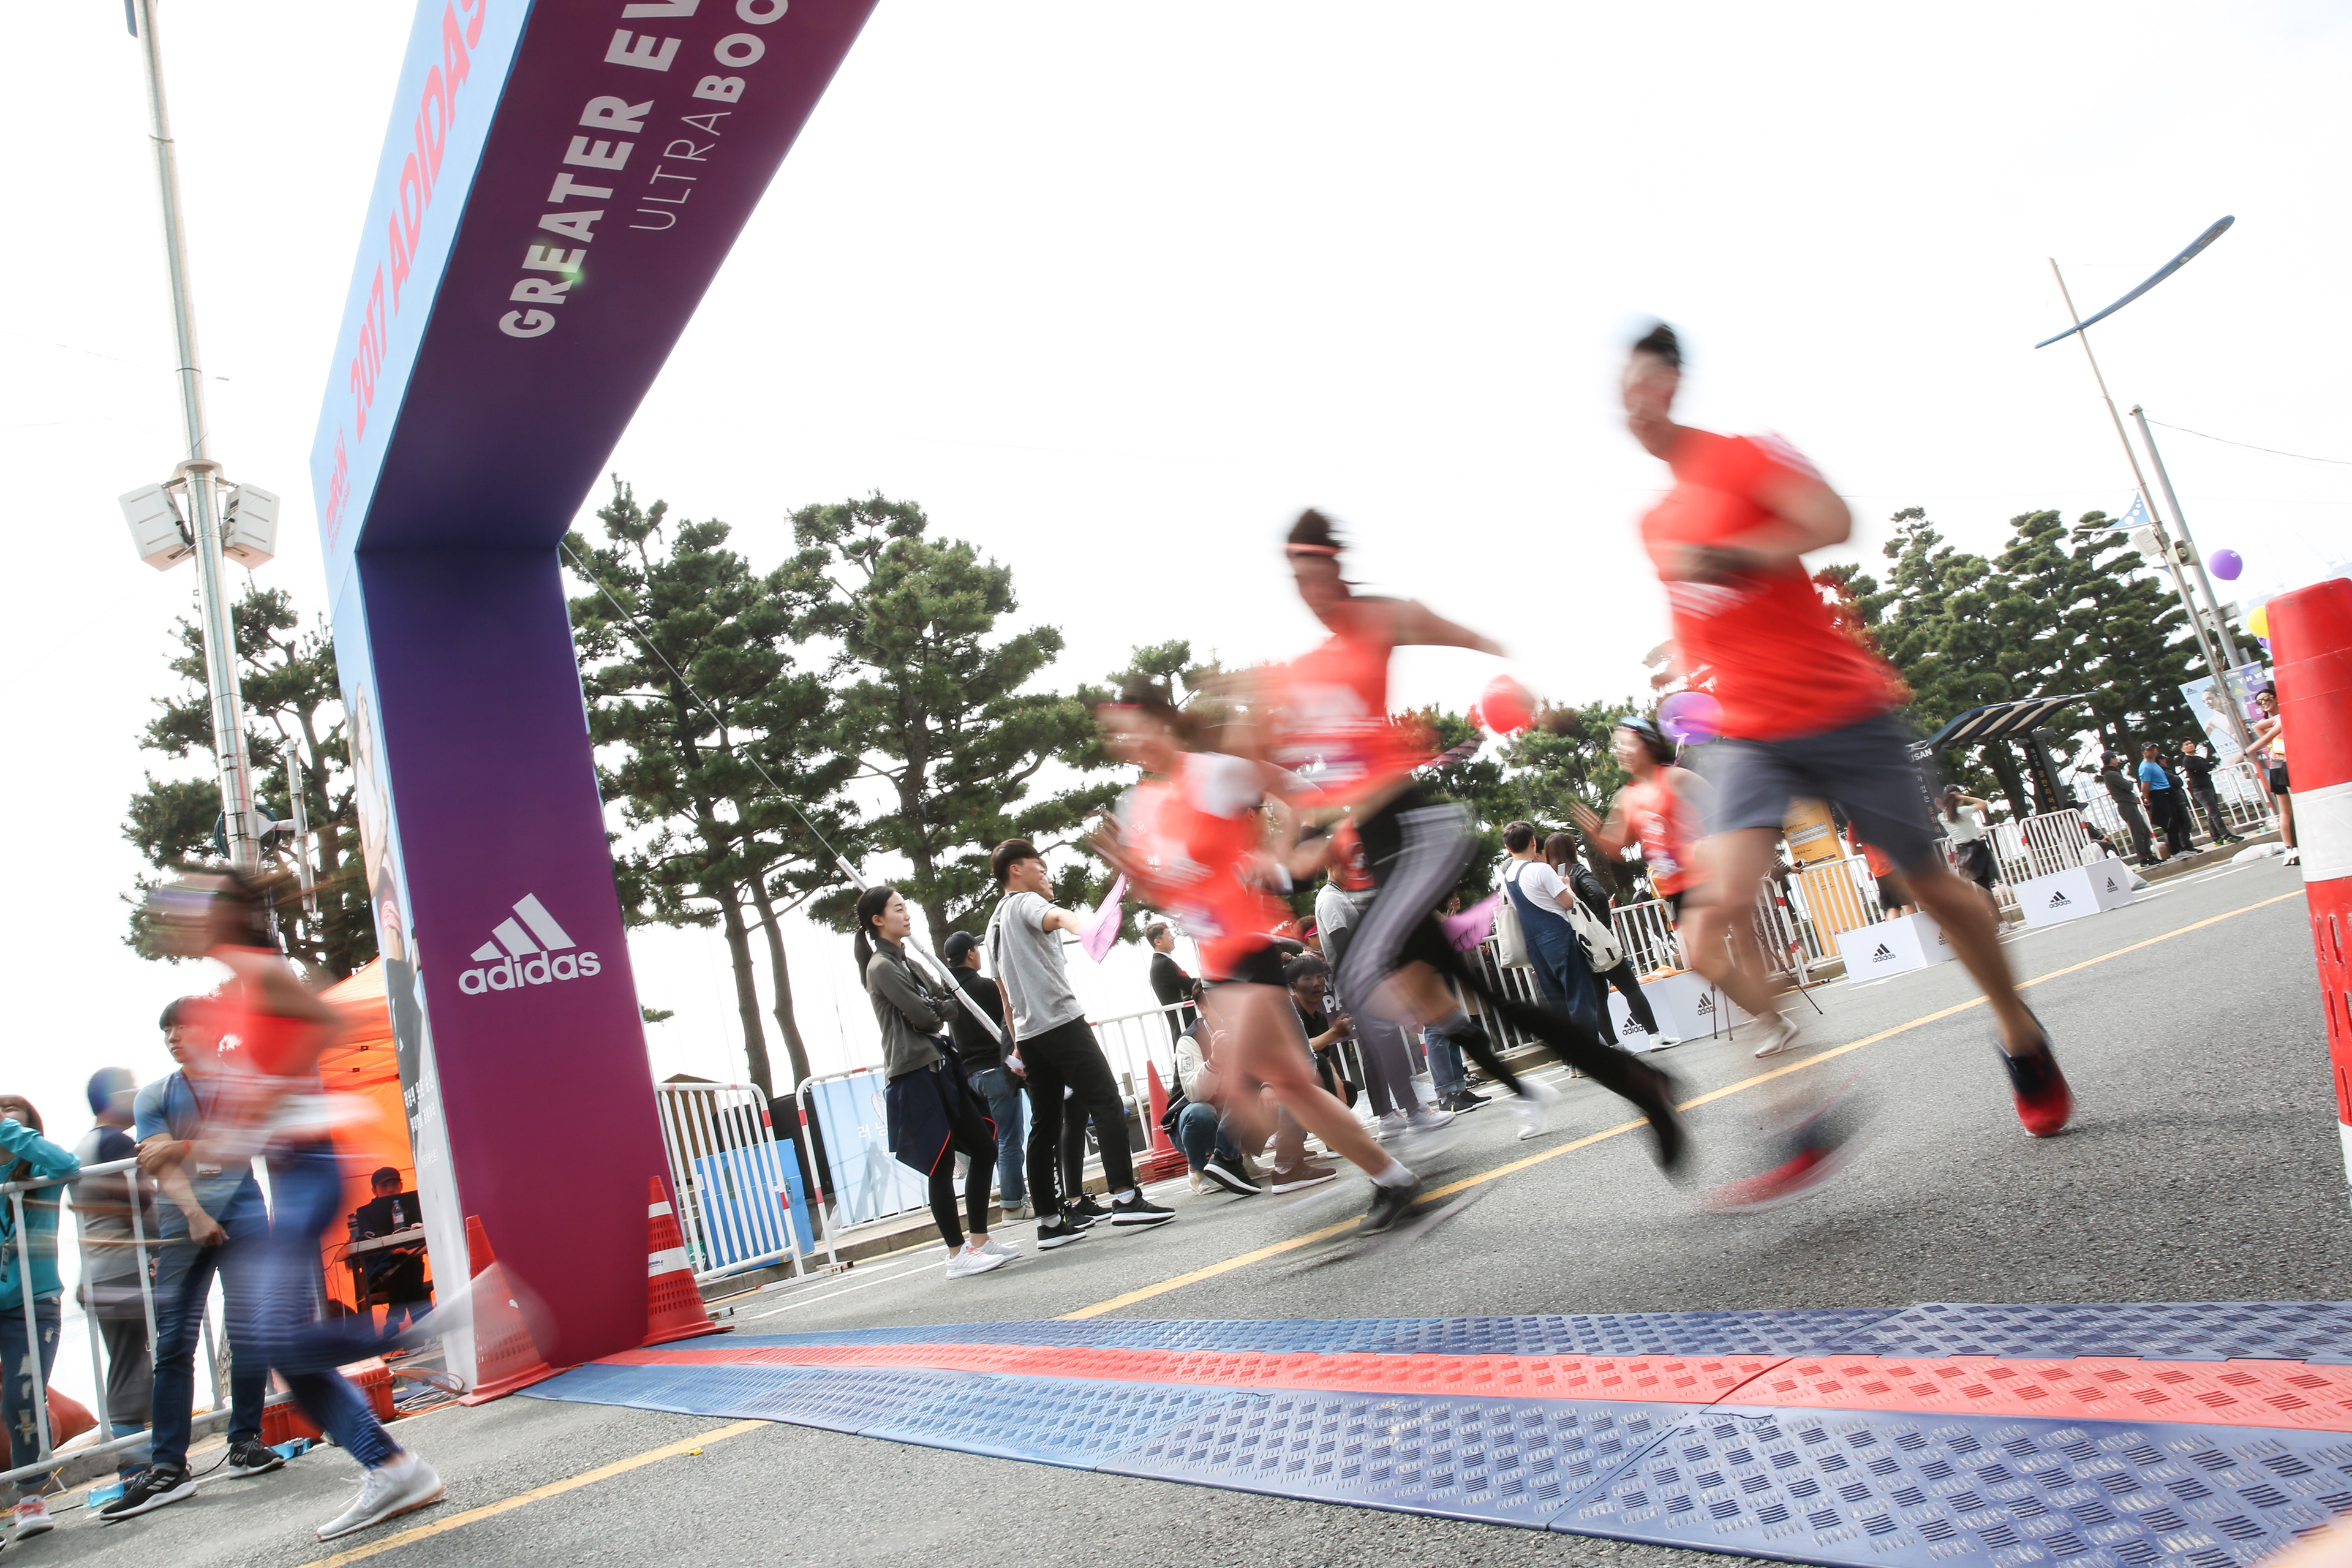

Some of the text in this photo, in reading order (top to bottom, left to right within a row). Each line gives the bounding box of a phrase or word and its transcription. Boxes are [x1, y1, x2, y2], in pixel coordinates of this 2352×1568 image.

[499, 96, 654, 338] GREATER
[350, 263, 386, 442] 2017
[1909, 748, 1933, 763] USAN
[2049, 899, 2071, 908] adidas
[1872, 953, 1896, 963] adidas
[459, 951, 601, 995] adidas
[1623, 1023, 1645, 1036] adida
